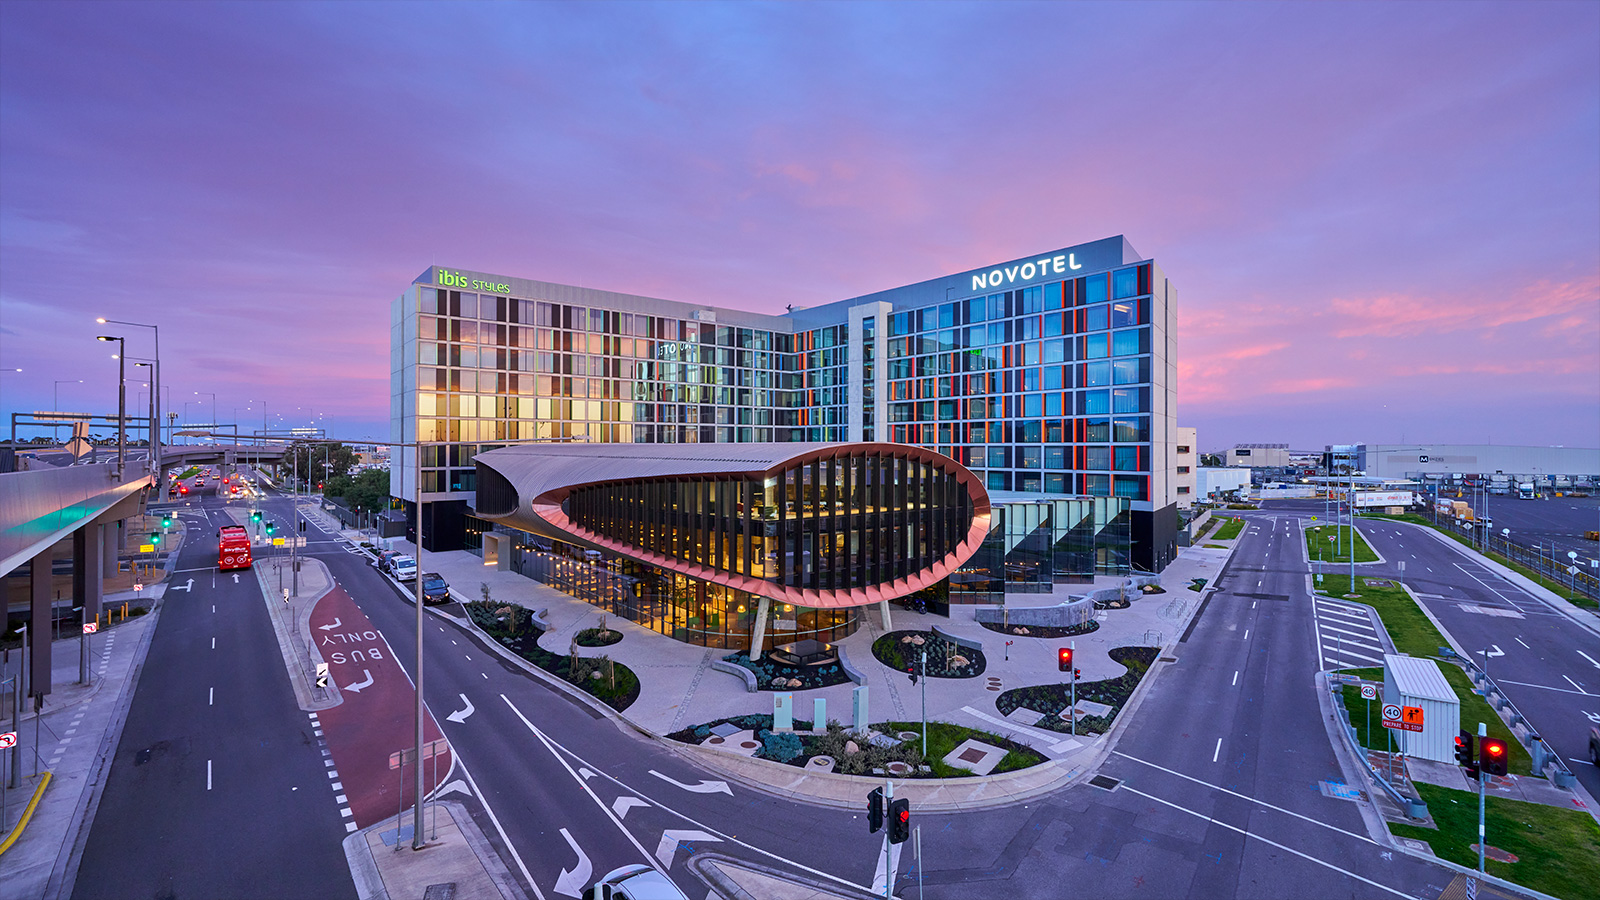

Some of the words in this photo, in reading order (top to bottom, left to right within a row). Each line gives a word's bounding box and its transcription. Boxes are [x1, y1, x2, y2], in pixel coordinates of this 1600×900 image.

[439, 269, 468, 288] ibis
[972, 253, 1082, 291] NOVOTEL
[322, 631, 377, 646] ONLY
[331, 648, 383, 664] BUS
